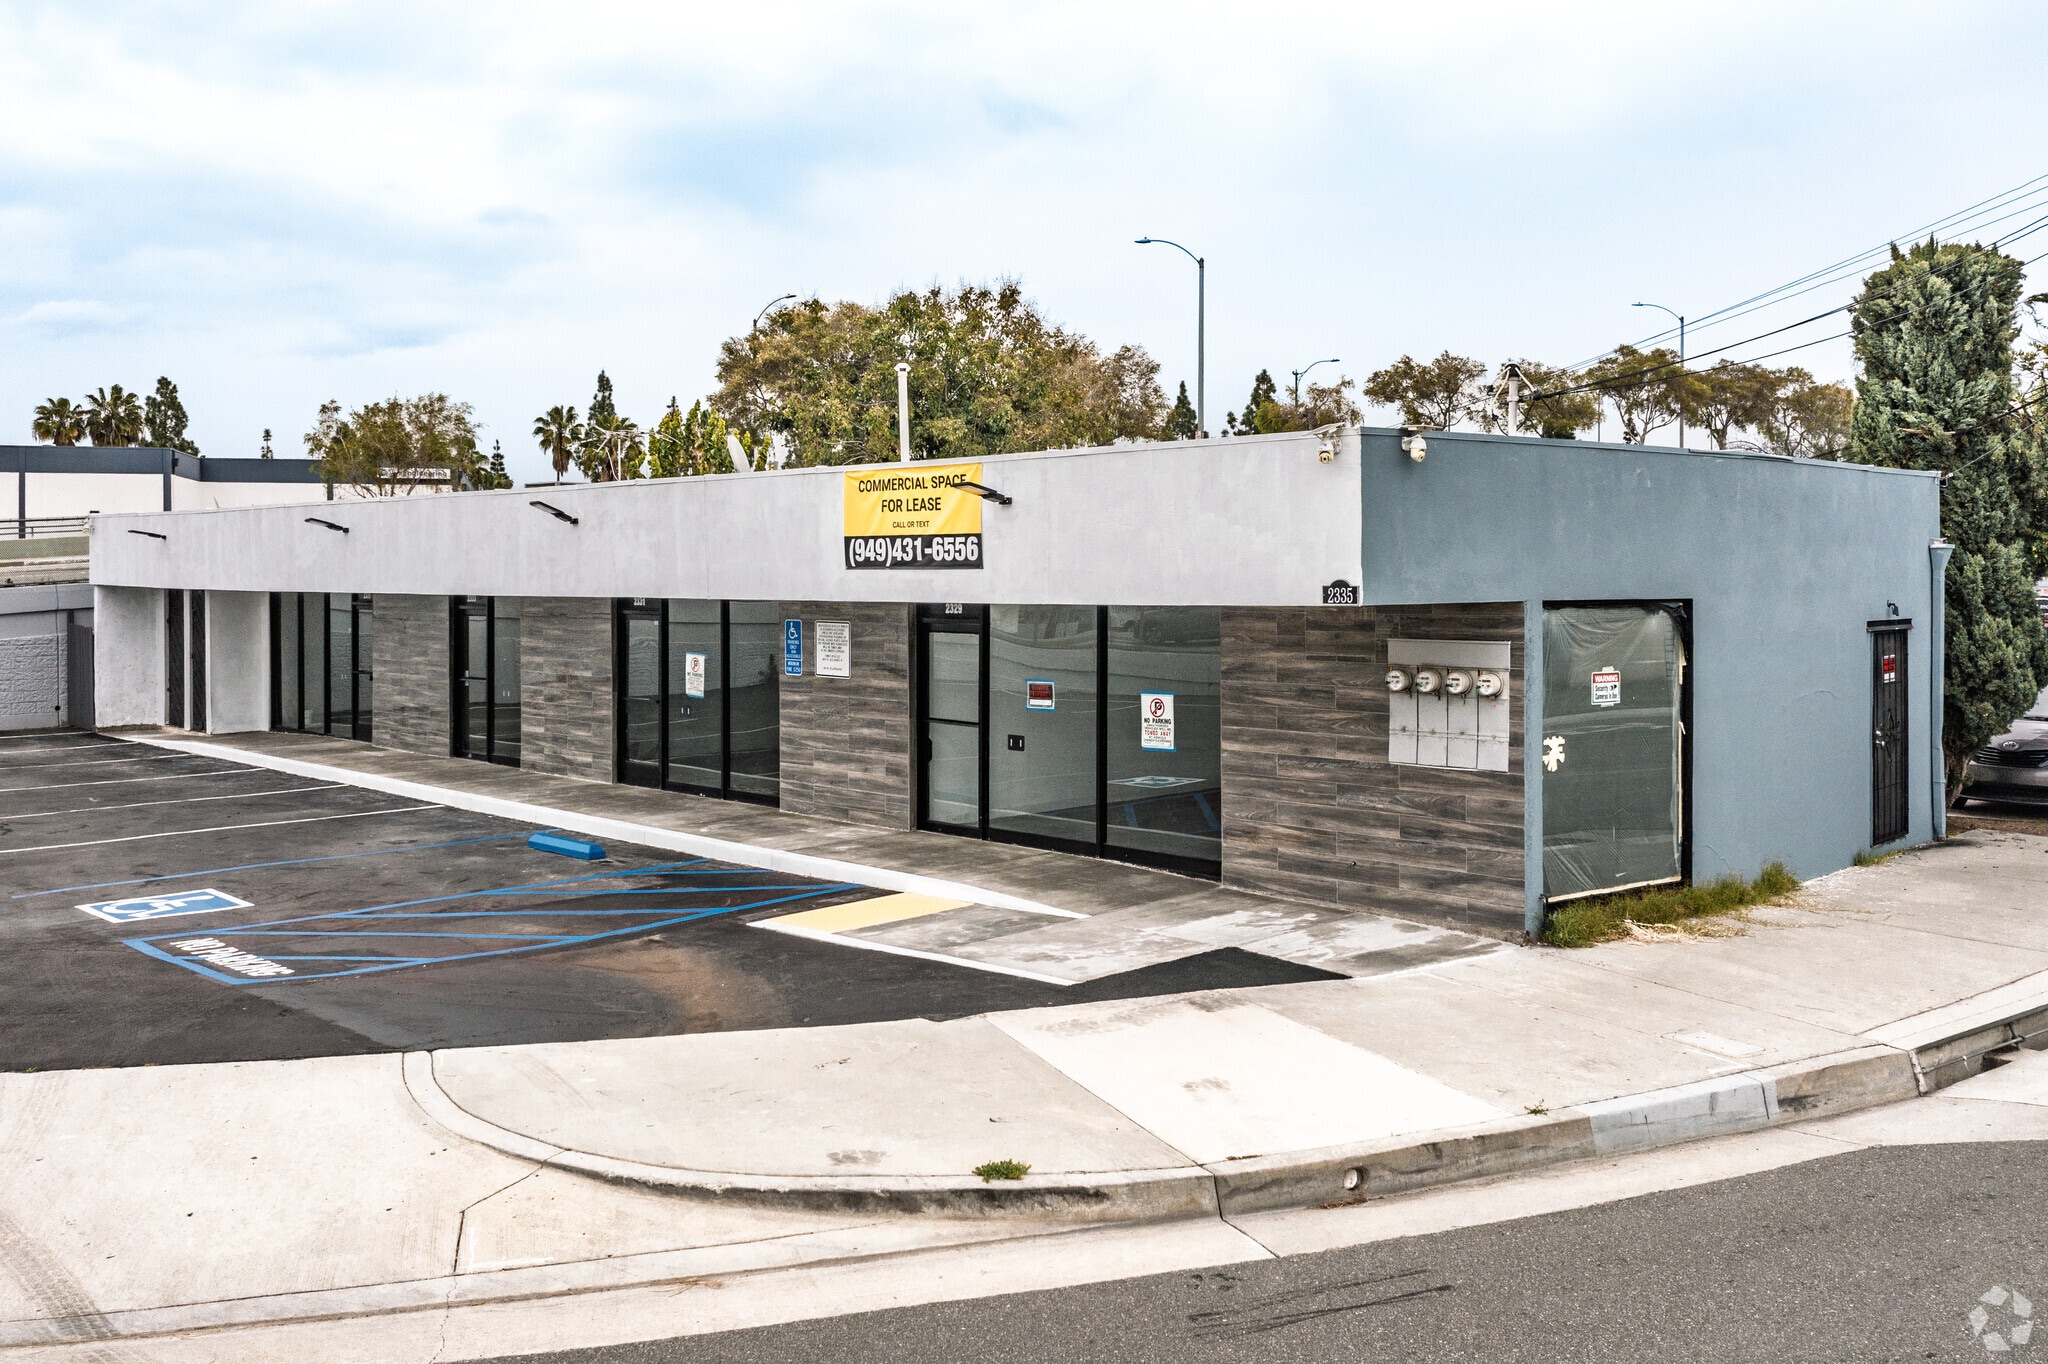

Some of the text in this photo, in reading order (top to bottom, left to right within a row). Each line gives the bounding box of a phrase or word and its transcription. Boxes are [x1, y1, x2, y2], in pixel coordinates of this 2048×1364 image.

[858, 477, 928, 492] COMMERCIAL
[881, 497, 942, 512] FOR LEASE
[849, 536, 979, 567] (949)431-6556
[1327, 587, 1354, 604] 2335
[945, 603, 963, 614] 2329
[1594, 674, 1618, 683] WARNING
[169, 937, 295, 976] NO PARKING
